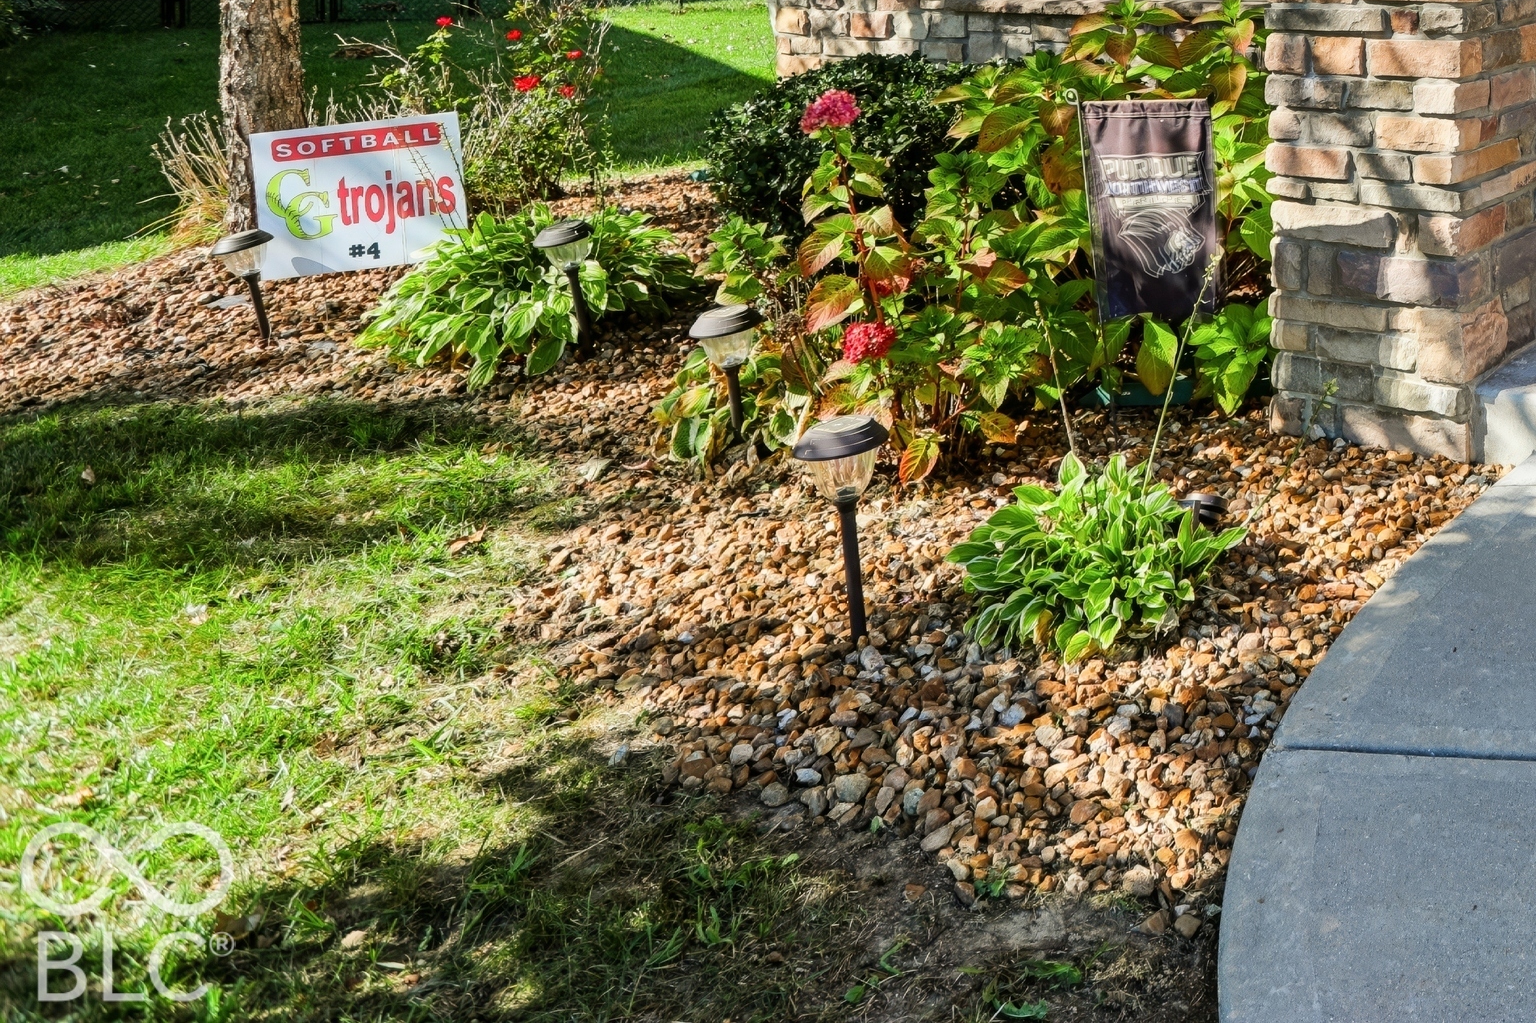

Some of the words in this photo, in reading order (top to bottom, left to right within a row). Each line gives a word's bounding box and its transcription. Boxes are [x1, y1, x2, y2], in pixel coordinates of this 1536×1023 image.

[275, 128, 438, 158] SOFTBALL
[1101, 156, 1200, 181] PURDUE
[337, 170, 457, 235] trojans
[348, 241, 381, 260] #4
